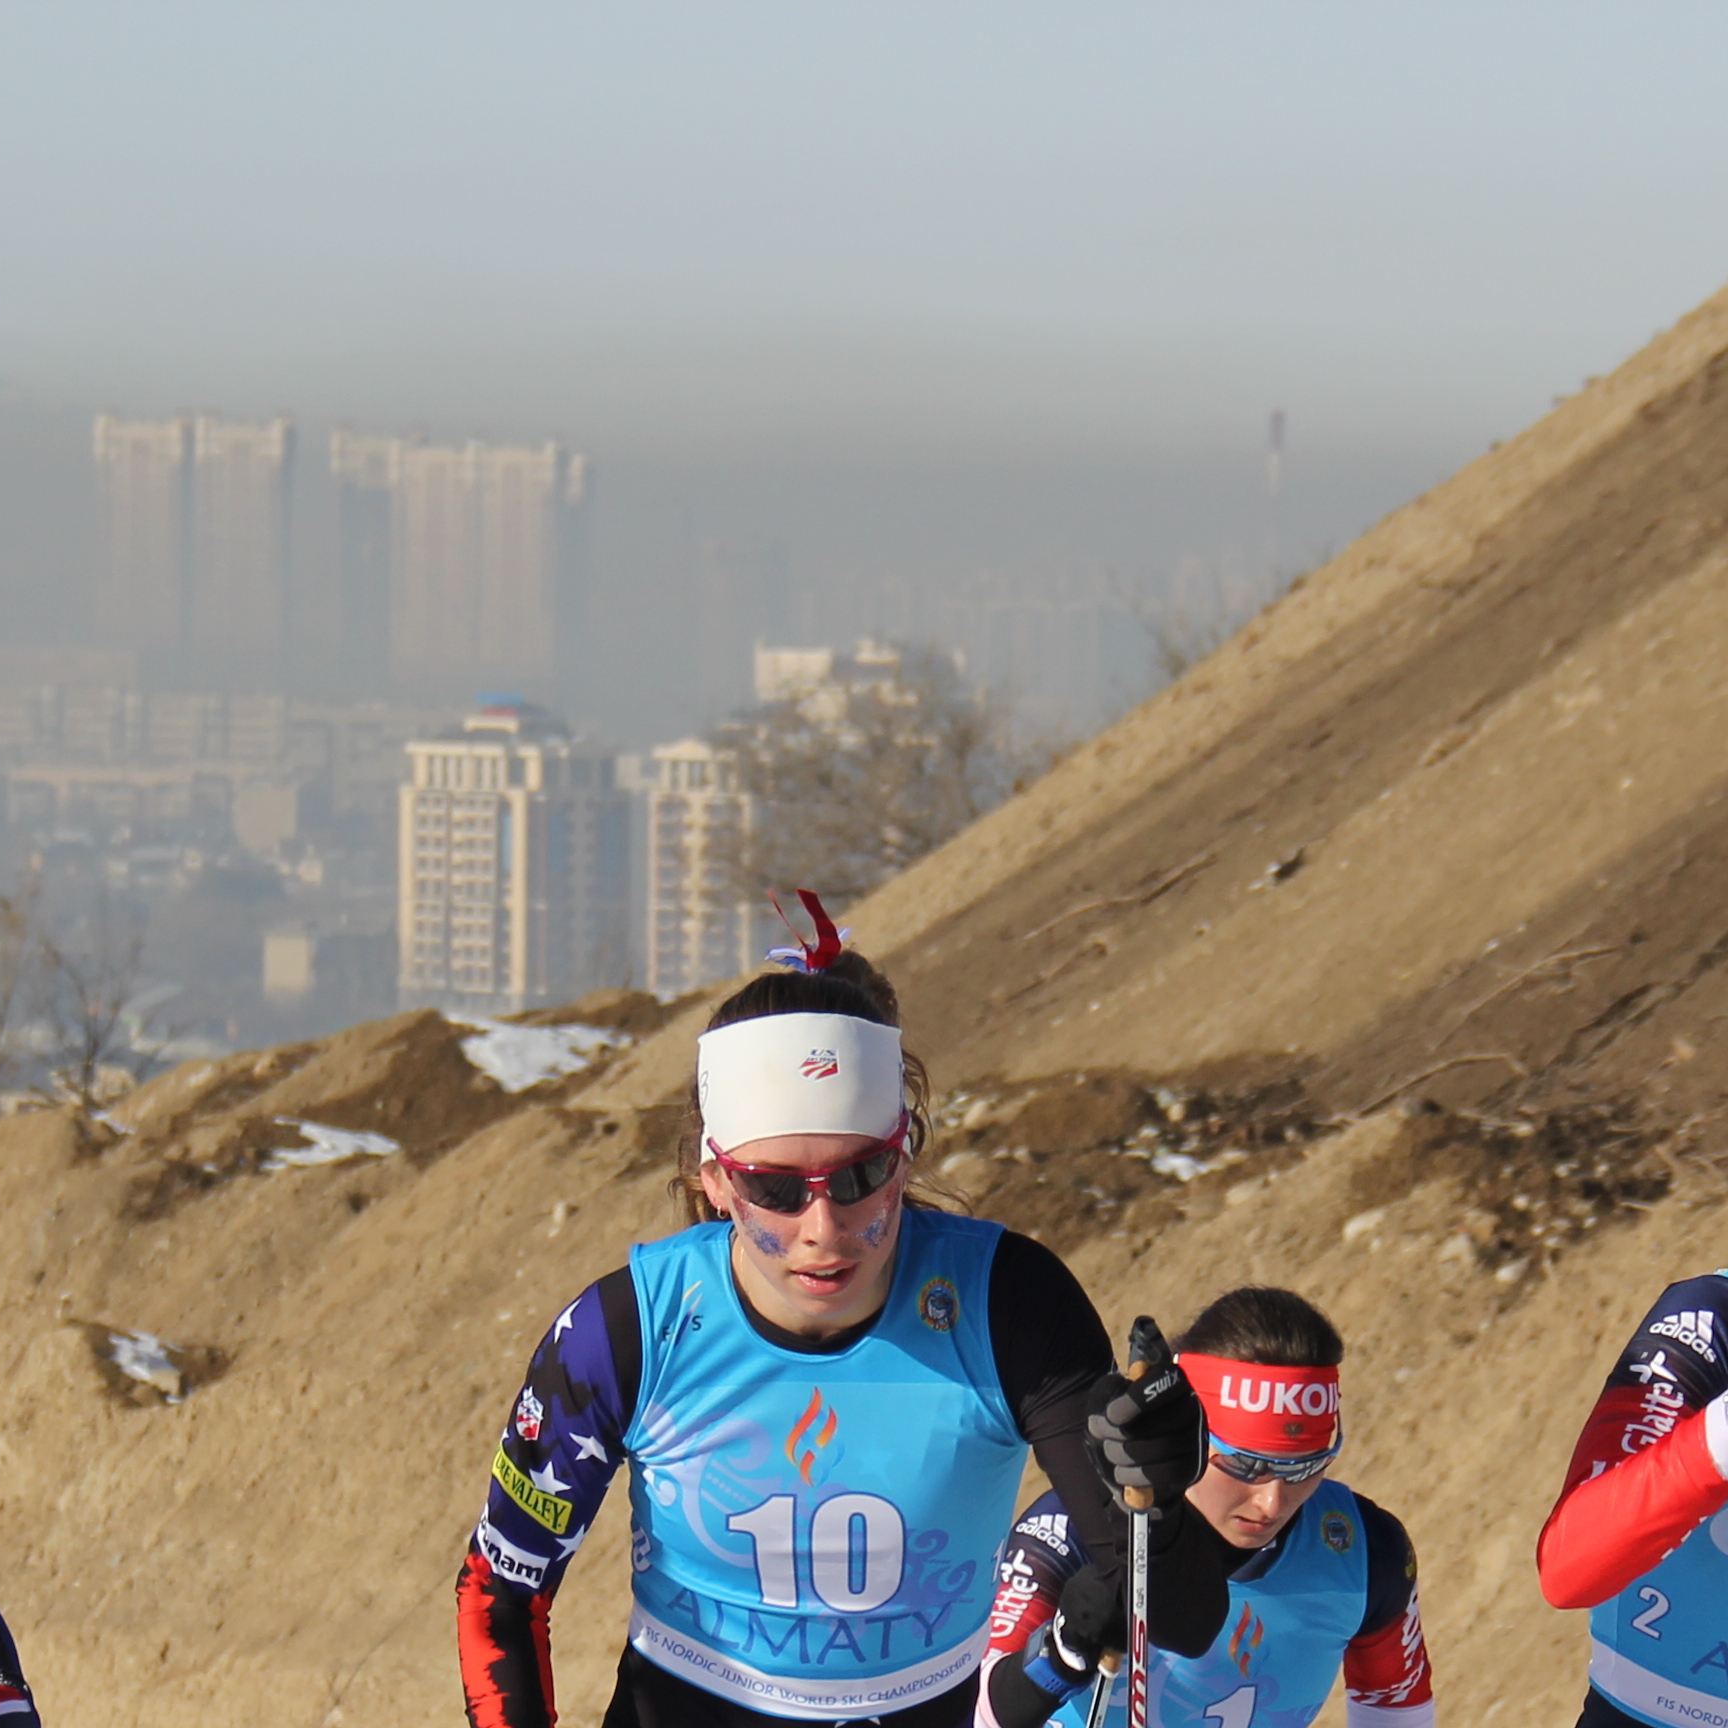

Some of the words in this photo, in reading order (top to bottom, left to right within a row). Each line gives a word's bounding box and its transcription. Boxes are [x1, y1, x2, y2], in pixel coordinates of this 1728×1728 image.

[1648, 1321, 1717, 1364] adidas
[725, 1491, 907, 1614] 10
[1015, 1520, 1070, 1558] adidas
[667, 1588, 955, 1665] ALMATY
[1630, 1584, 1671, 1641] 2
[645, 1625, 660, 1644] FIS
[661, 1635, 718, 1675] NORDIC
[718, 1666, 774, 1696] JUNIOR
[778, 1688, 838, 1706] WORLD
[841, 1691, 865, 1706] SKI
[867, 1650, 974, 1704] CHAMPIONSHIPS
[1655, 1695, 1676, 1712] FIS
